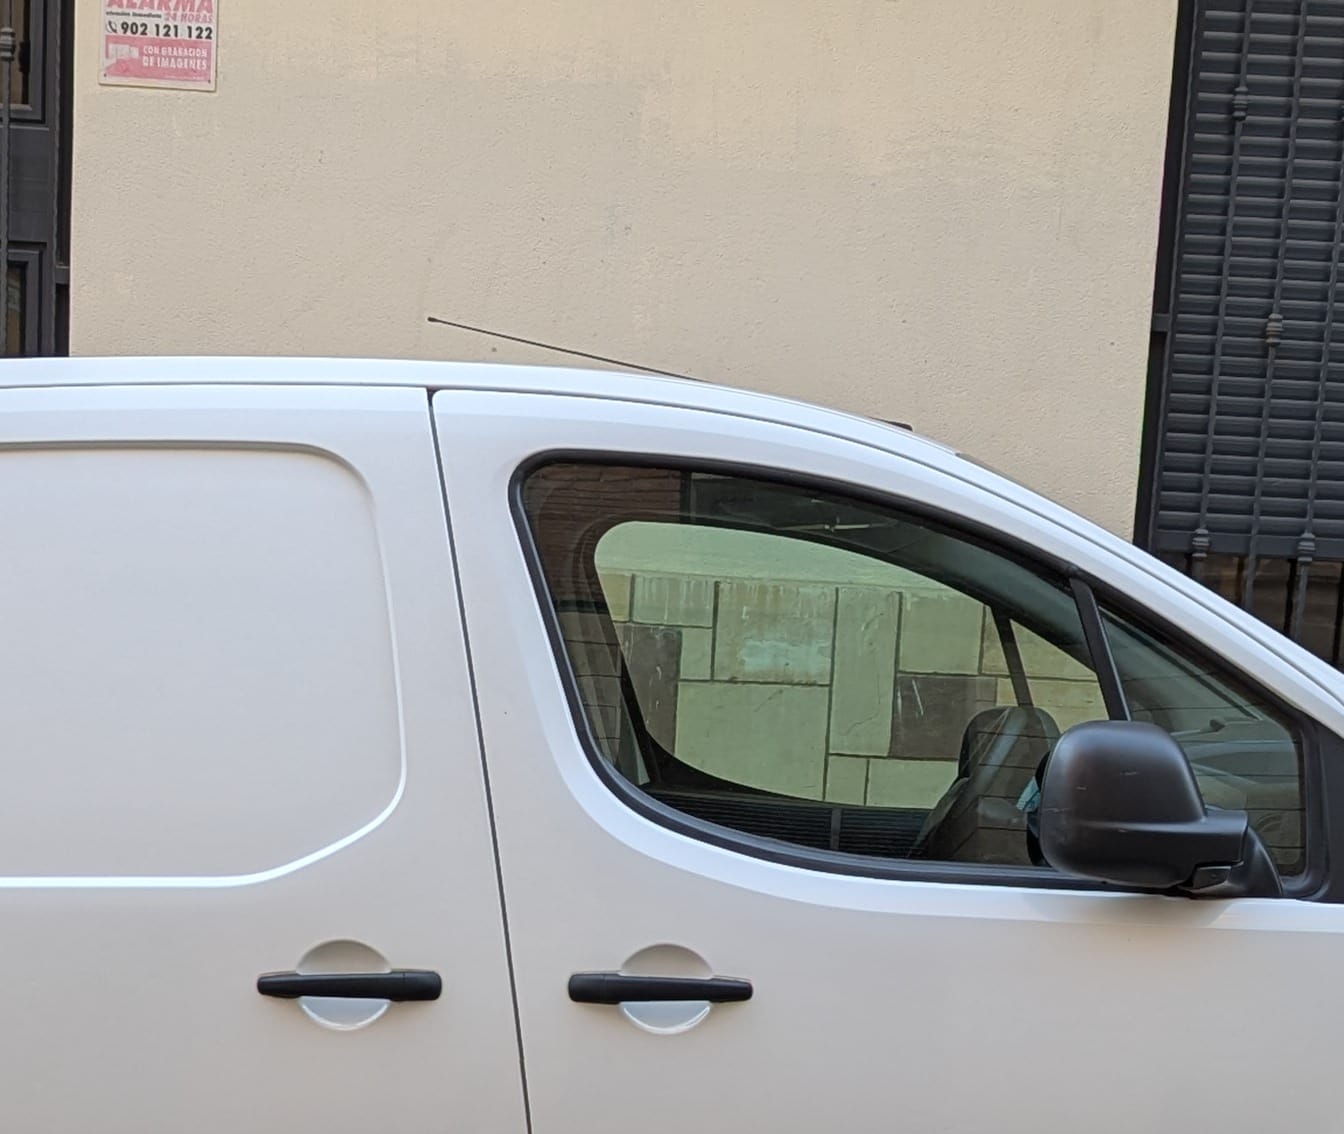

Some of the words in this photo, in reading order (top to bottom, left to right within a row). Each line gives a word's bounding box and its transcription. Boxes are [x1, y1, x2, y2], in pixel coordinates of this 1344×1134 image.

[181, 13, 213, 24] HORAS
[121, 22, 148, 36] 902
[155, 24, 178, 38] 121
[187, 26, 213, 40] 122
